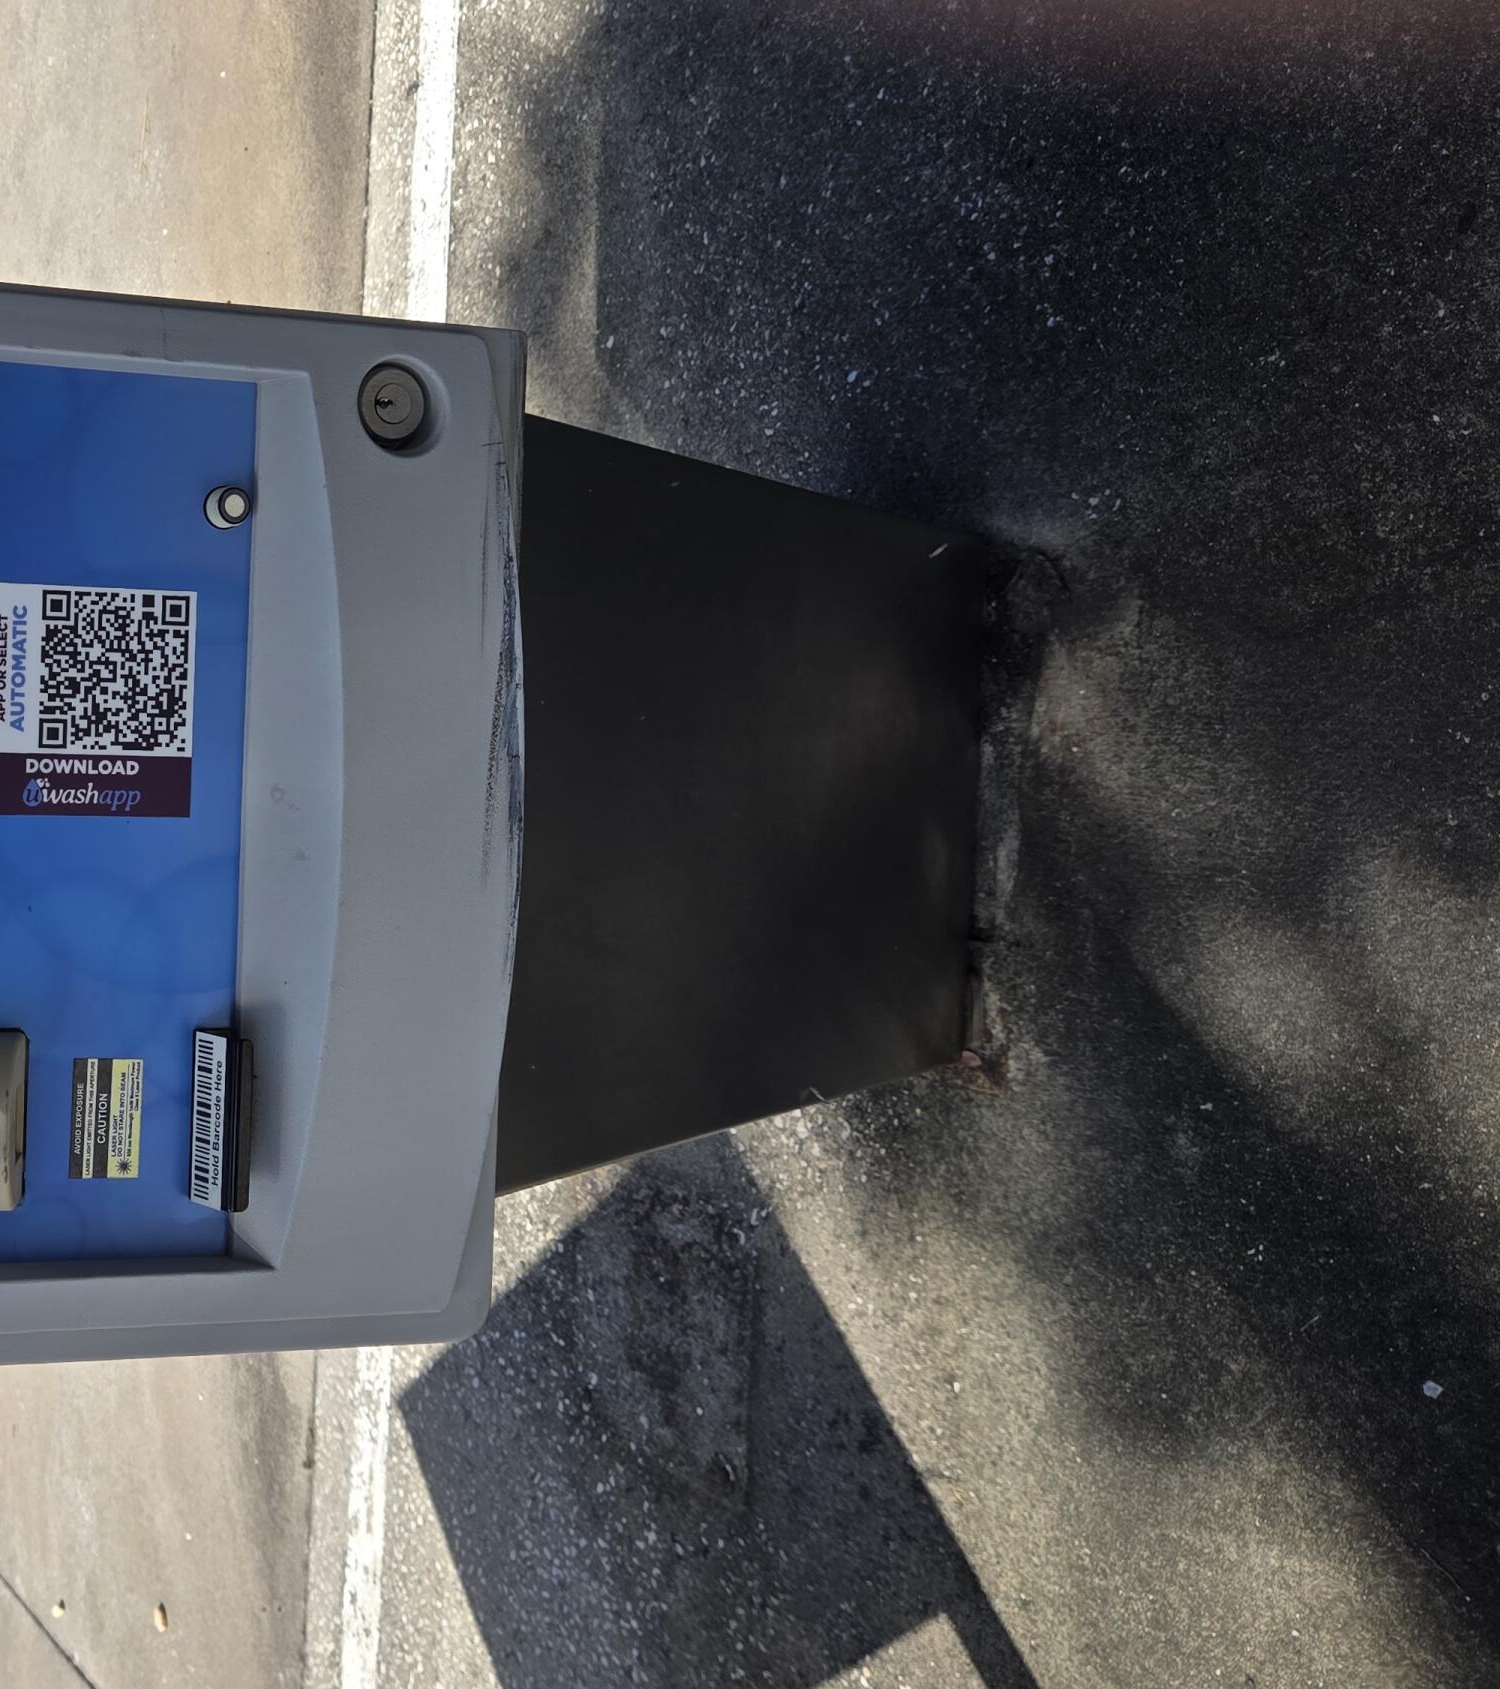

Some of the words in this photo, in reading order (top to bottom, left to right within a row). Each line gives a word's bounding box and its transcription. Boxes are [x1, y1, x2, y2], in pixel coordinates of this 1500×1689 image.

[9, 604, 28, 732] AUTOMATIC
[26, 758, 140, 775] DOWNLOAD
[214, 1060, 223, 1092] Here
[75, 1082, 84, 1128] EXPOSURE
[97, 1093, 108, 1144] CAUTION
[212, 1095, 222, 1152] Barcode
[74, 1130, 82, 1154] AVOID
[117, 1147, 123, 1157] DO
[210, 1154, 220, 1186] Hold
